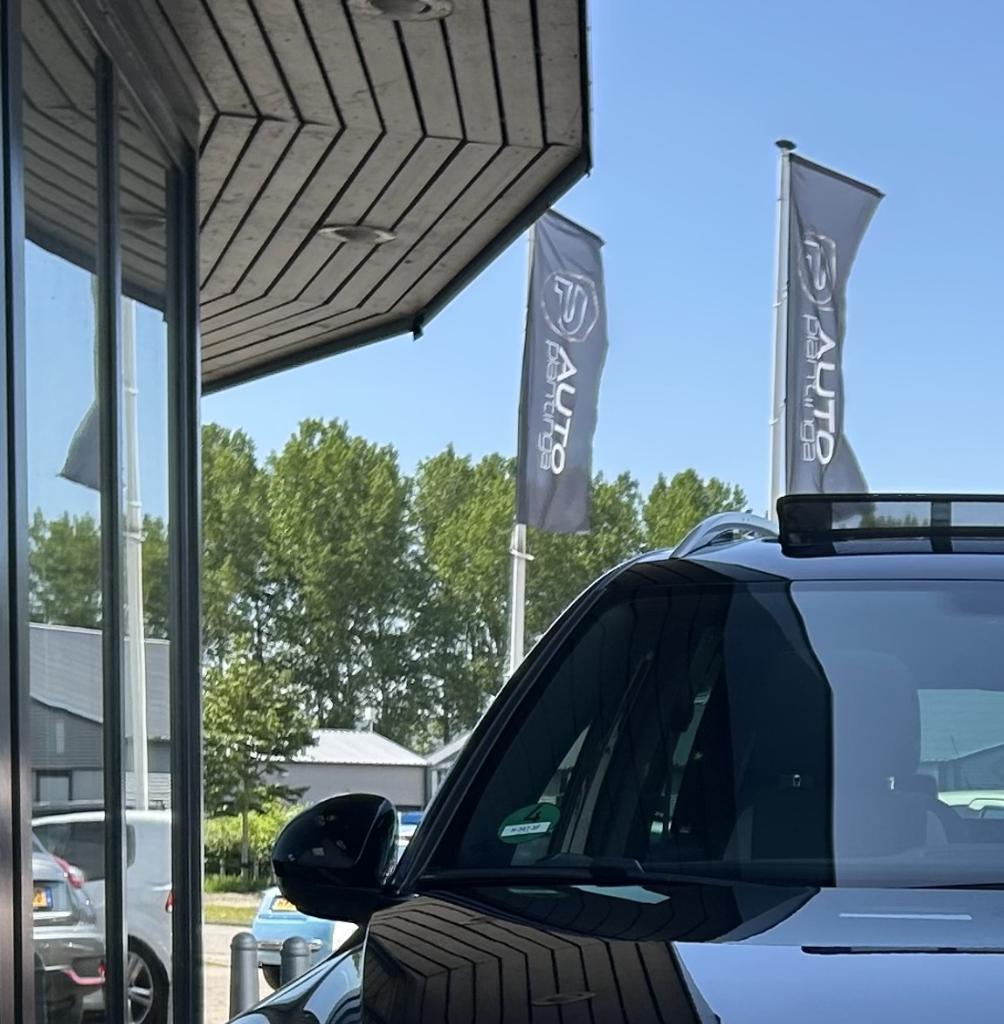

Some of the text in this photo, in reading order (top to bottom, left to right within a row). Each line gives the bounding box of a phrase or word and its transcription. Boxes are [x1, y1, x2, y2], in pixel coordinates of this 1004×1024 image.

[538, 339, 561, 471] plantinga
[551, 346, 578, 475] AUTO
[813, 322, 836, 464] AUTO
